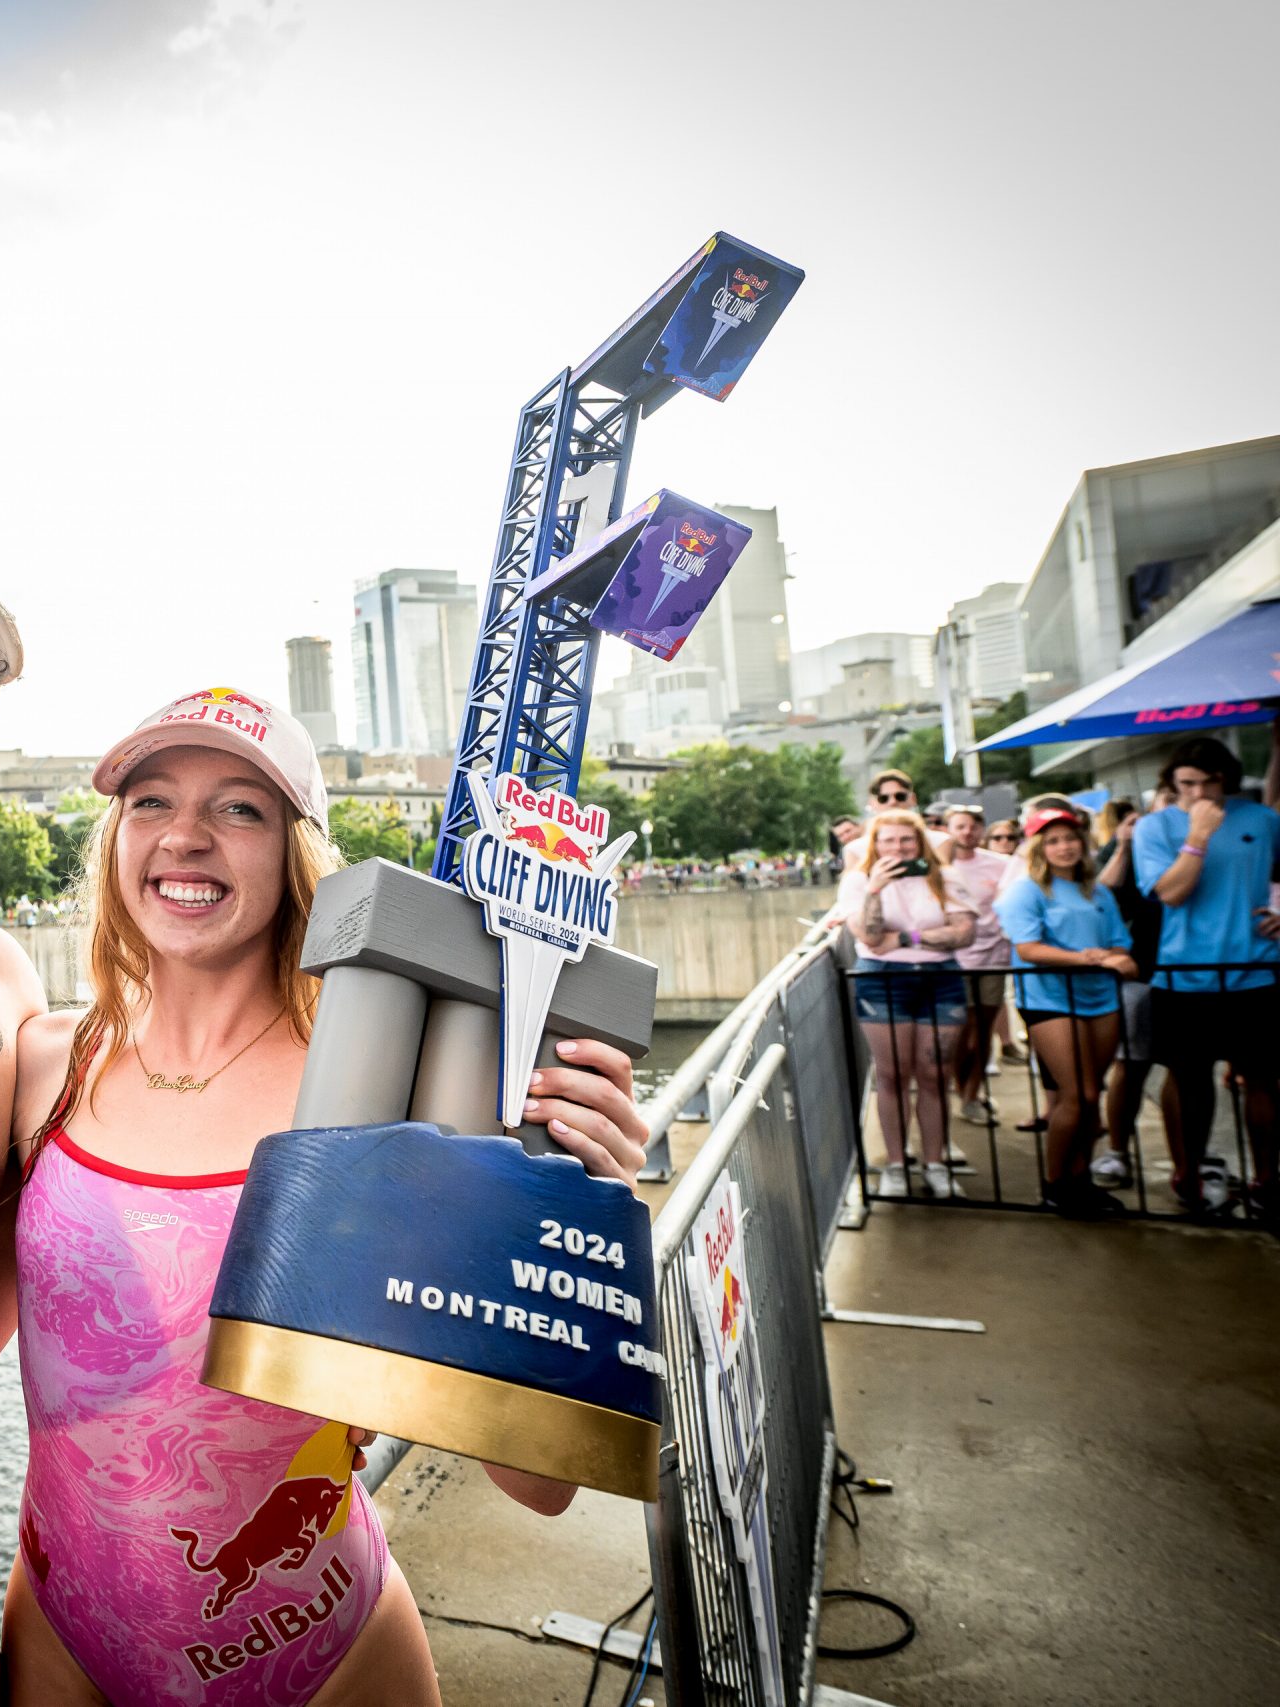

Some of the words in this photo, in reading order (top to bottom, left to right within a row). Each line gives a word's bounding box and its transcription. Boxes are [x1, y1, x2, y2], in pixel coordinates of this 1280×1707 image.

[733, 268, 752, 284] Red
[751, 275, 768, 291] Bull
[728, 298, 759, 322] DIVING
[680, 522, 701, 538] Red
[699, 529, 717, 545] Bull
[677, 551, 709, 577] DIVING
[214, 709, 267, 742] Bull
[506, 778, 555, 819] Red
[557, 798, 605, 838] Bull
[476, 833, 531, 904] CLIFF
[534, 862, 612, 937] DIVING
[499, 904, 526, 922] WORLD
[530, 916, 556, 934] SERIES
[560, 927, 580, 943] 2024
[509, 921, 543, 939] MONTREAL
[547, 935, 568, 948] CANADA
[123, 1209, 179, 1225] speedo
[539, 1219, 625, 1270] 2024
[511, 1258, 643, 1326] WOMEN
[386, 1277, 591, 1352] MONTREAL
[182, 1614, 280, 1683] Red
[267, 1553, 355, 1644] Bull
